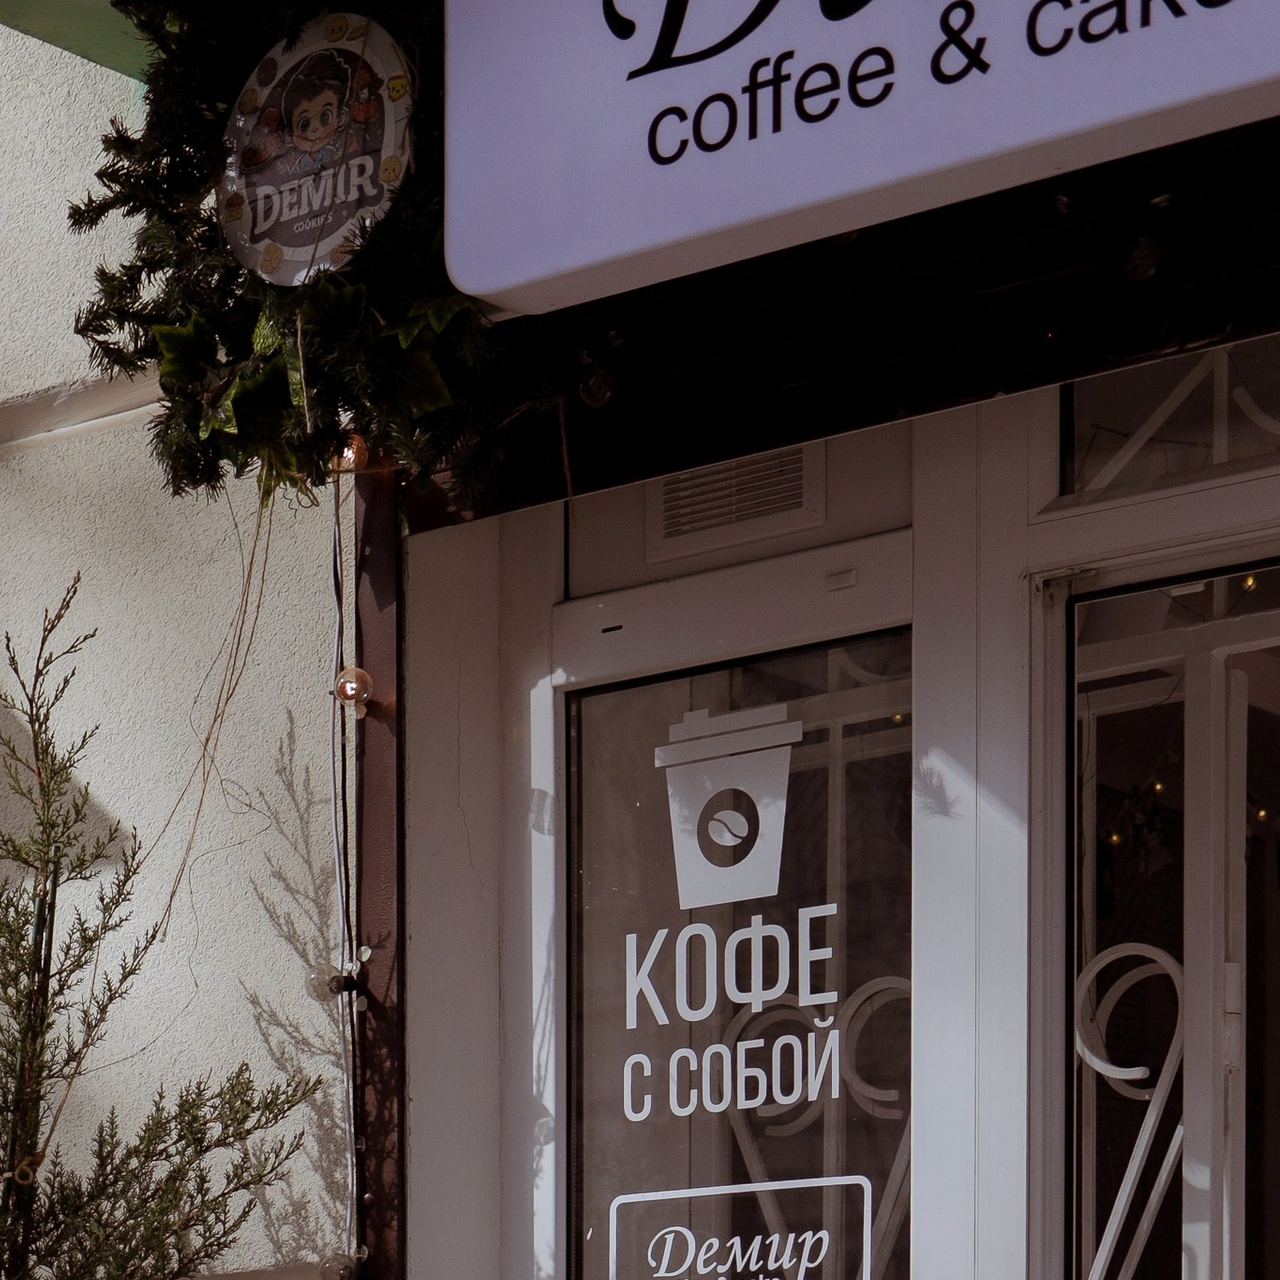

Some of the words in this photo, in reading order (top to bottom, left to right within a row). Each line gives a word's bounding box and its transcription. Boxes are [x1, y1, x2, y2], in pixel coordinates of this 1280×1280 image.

[647, 46, 896, 166] coffee
[930, 0, 991, 86] &
[254, 154, 377, 235] DEMIR
[625, 903, 839, 1030] КОФЕ
[623, 1053, 652, 1122] С
[669, 1016, 841, 1117] СОБОЙ
